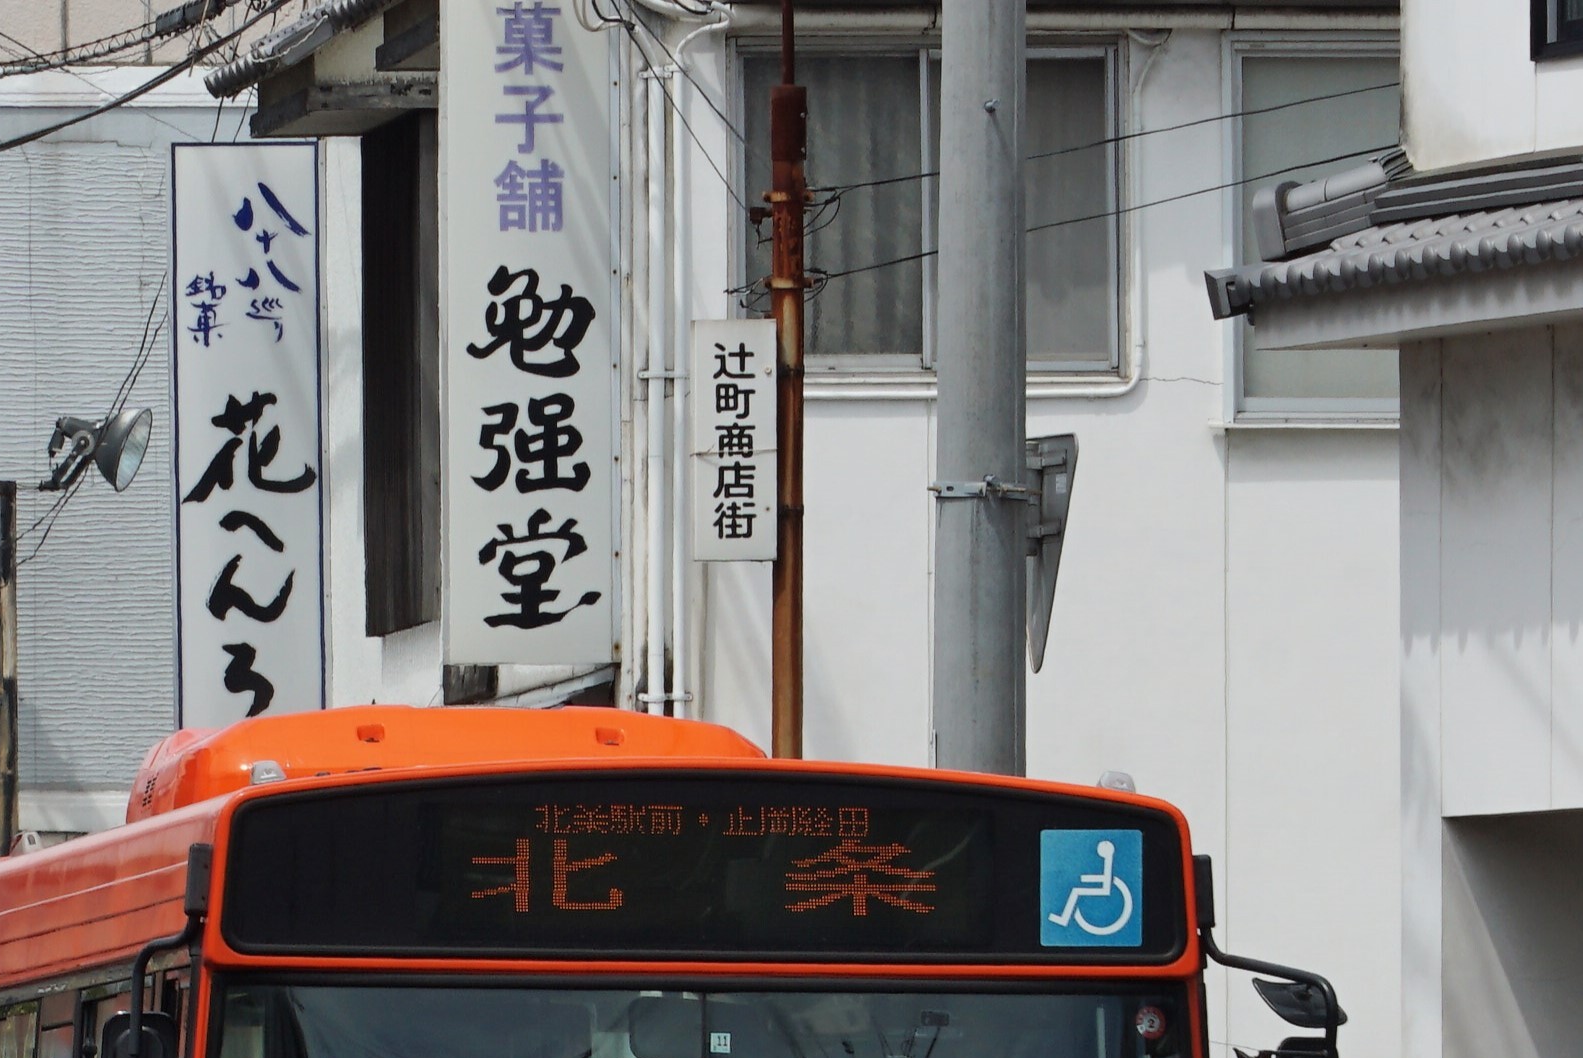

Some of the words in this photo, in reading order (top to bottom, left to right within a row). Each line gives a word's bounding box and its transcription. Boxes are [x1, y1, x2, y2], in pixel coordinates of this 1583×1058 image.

[494, 2, 565, 233] 菓子舗
[181, 392, 317, 718] 花へんろ
[712, 342, 756, 541] 辻町商店街
